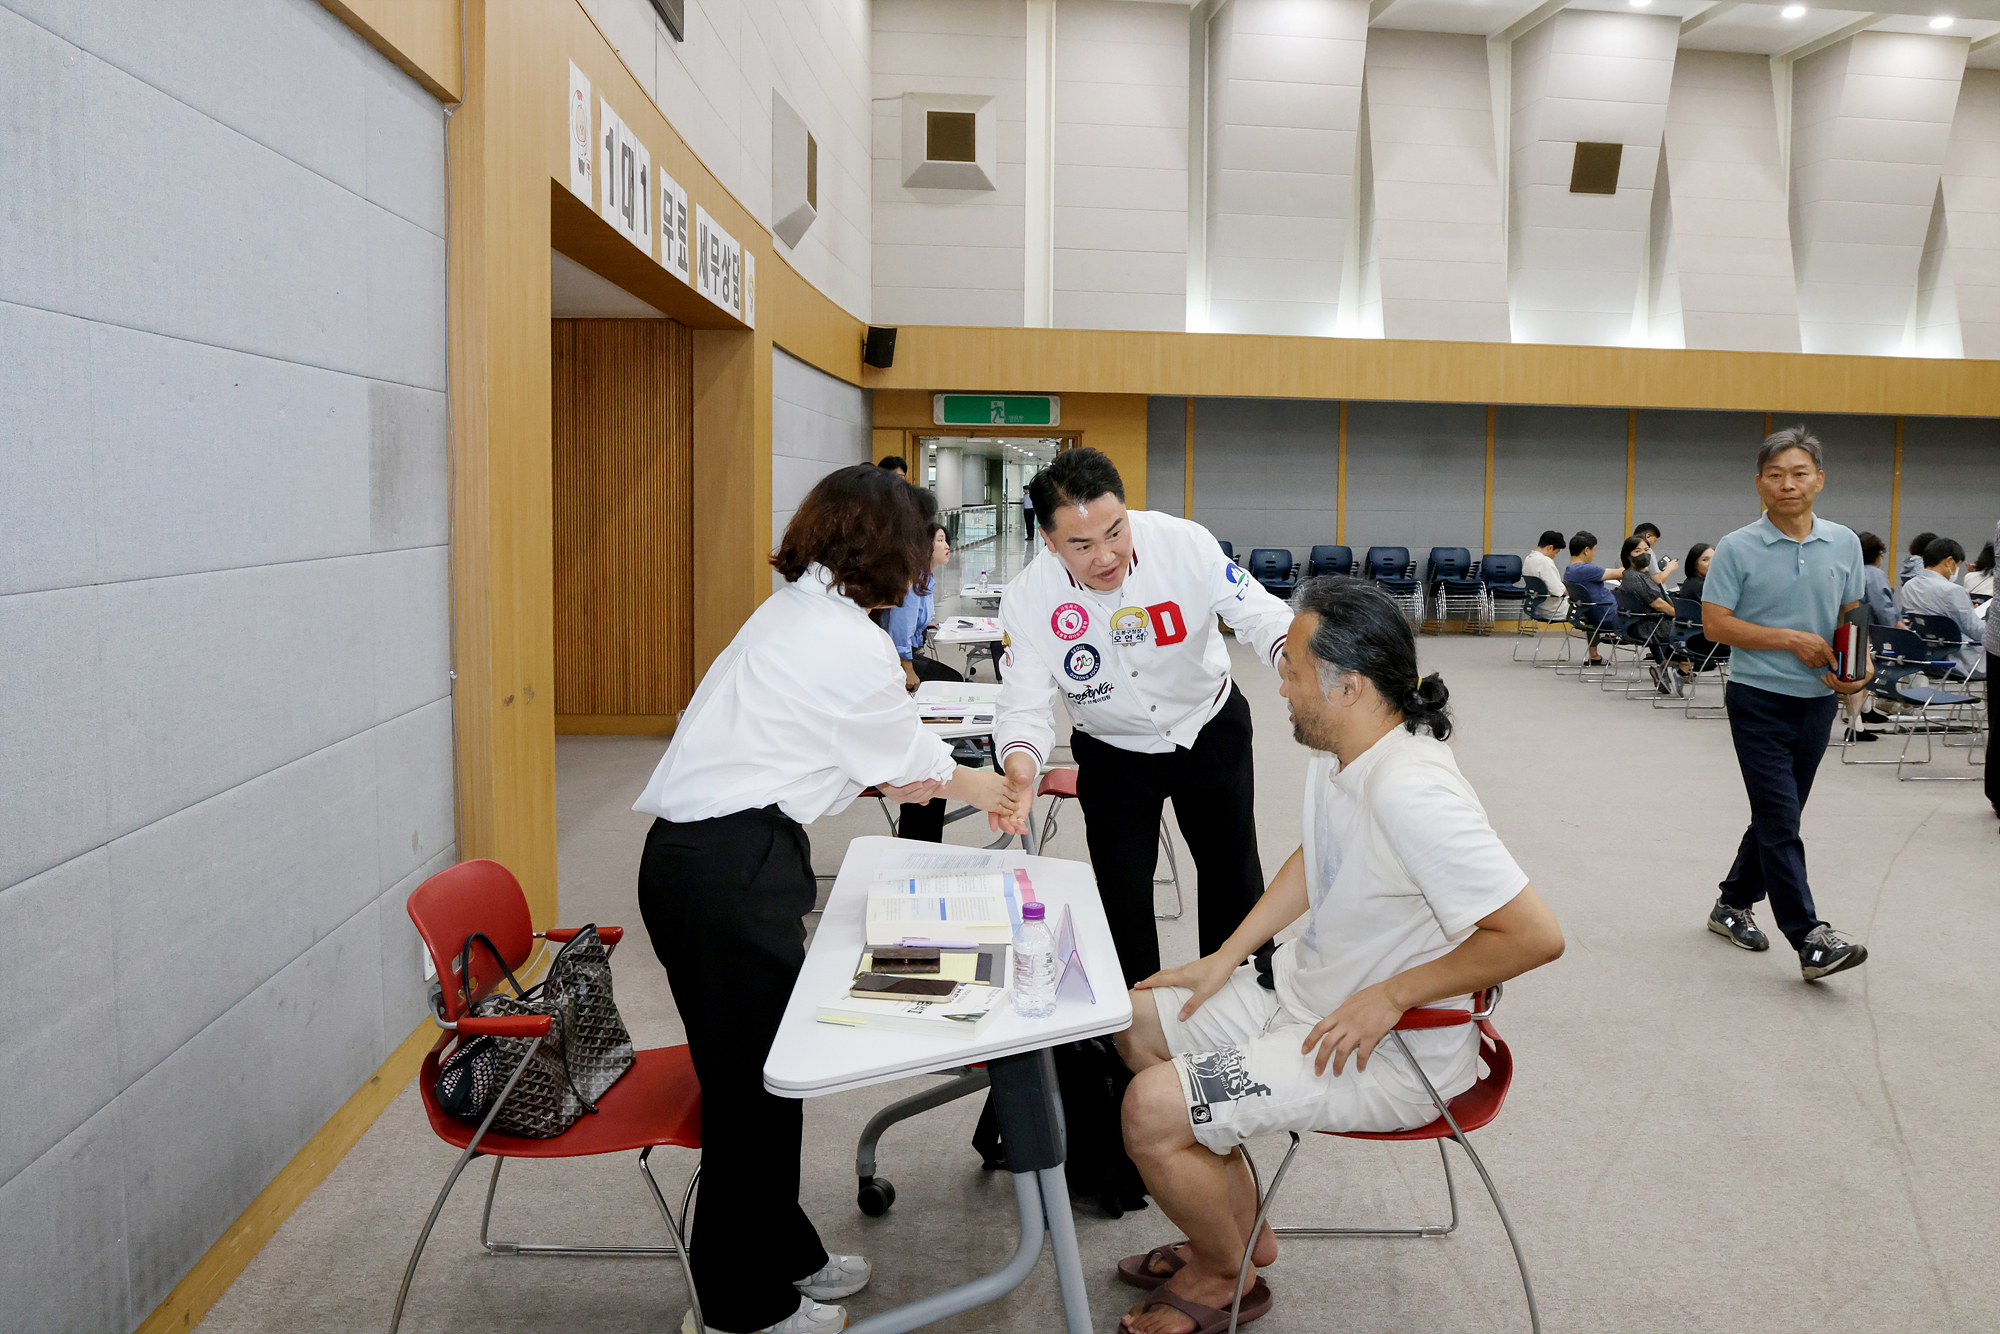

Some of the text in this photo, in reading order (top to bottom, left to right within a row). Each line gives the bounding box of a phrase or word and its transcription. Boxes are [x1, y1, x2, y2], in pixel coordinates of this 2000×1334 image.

[606, 127, 740, 310] 1대1 무료 세무상담
[1145, 600, 1188, 647] D
[1070, 644, 1086, 654] SEOUL
[1070, 662, 1100, 680] DOBONG SOCKS
